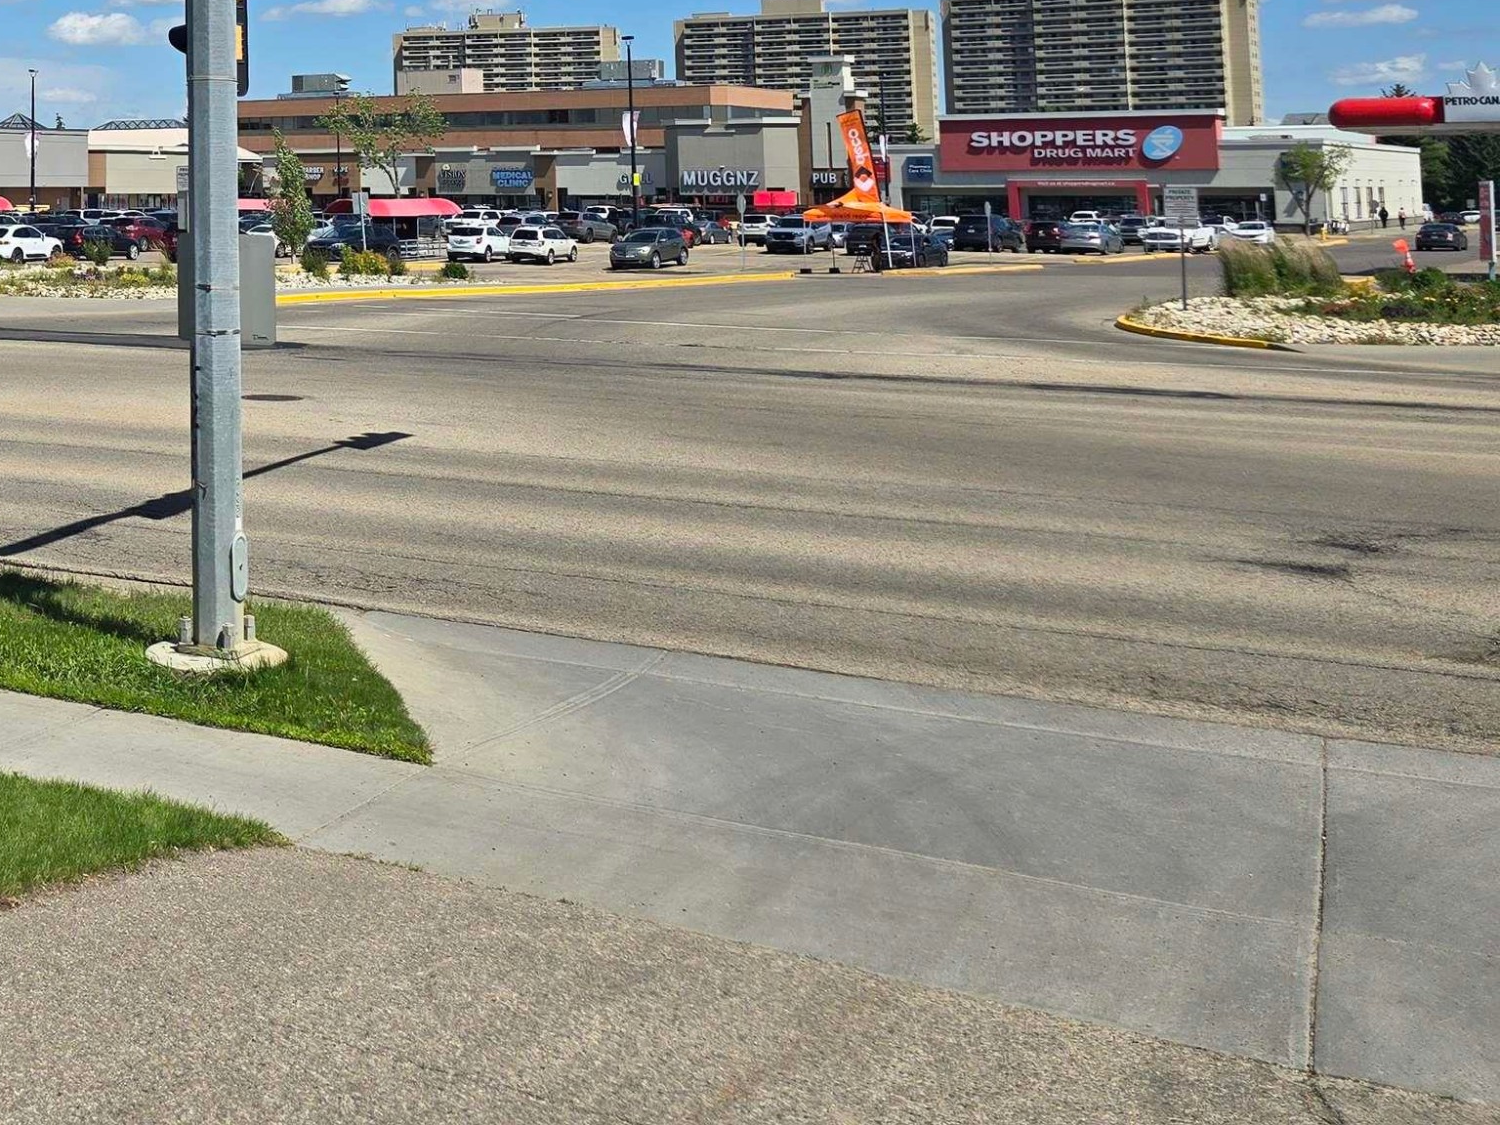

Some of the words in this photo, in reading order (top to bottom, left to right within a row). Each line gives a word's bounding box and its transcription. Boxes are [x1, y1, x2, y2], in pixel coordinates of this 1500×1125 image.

[1444, 95, 1500, 106] PETRO-CAN
[969, 129, 1138, 148] SHOPPERS
[1033, 148, 1083, 159] DRUG
[1086, 146, 1136, 159] MART
[492, 171, 534, 180] MEDICAL
[683, 170, 760, 187] MUGGNZ
[812, 172, 838, 185] PUB
[497, 179, 530, 188] CLINIC
